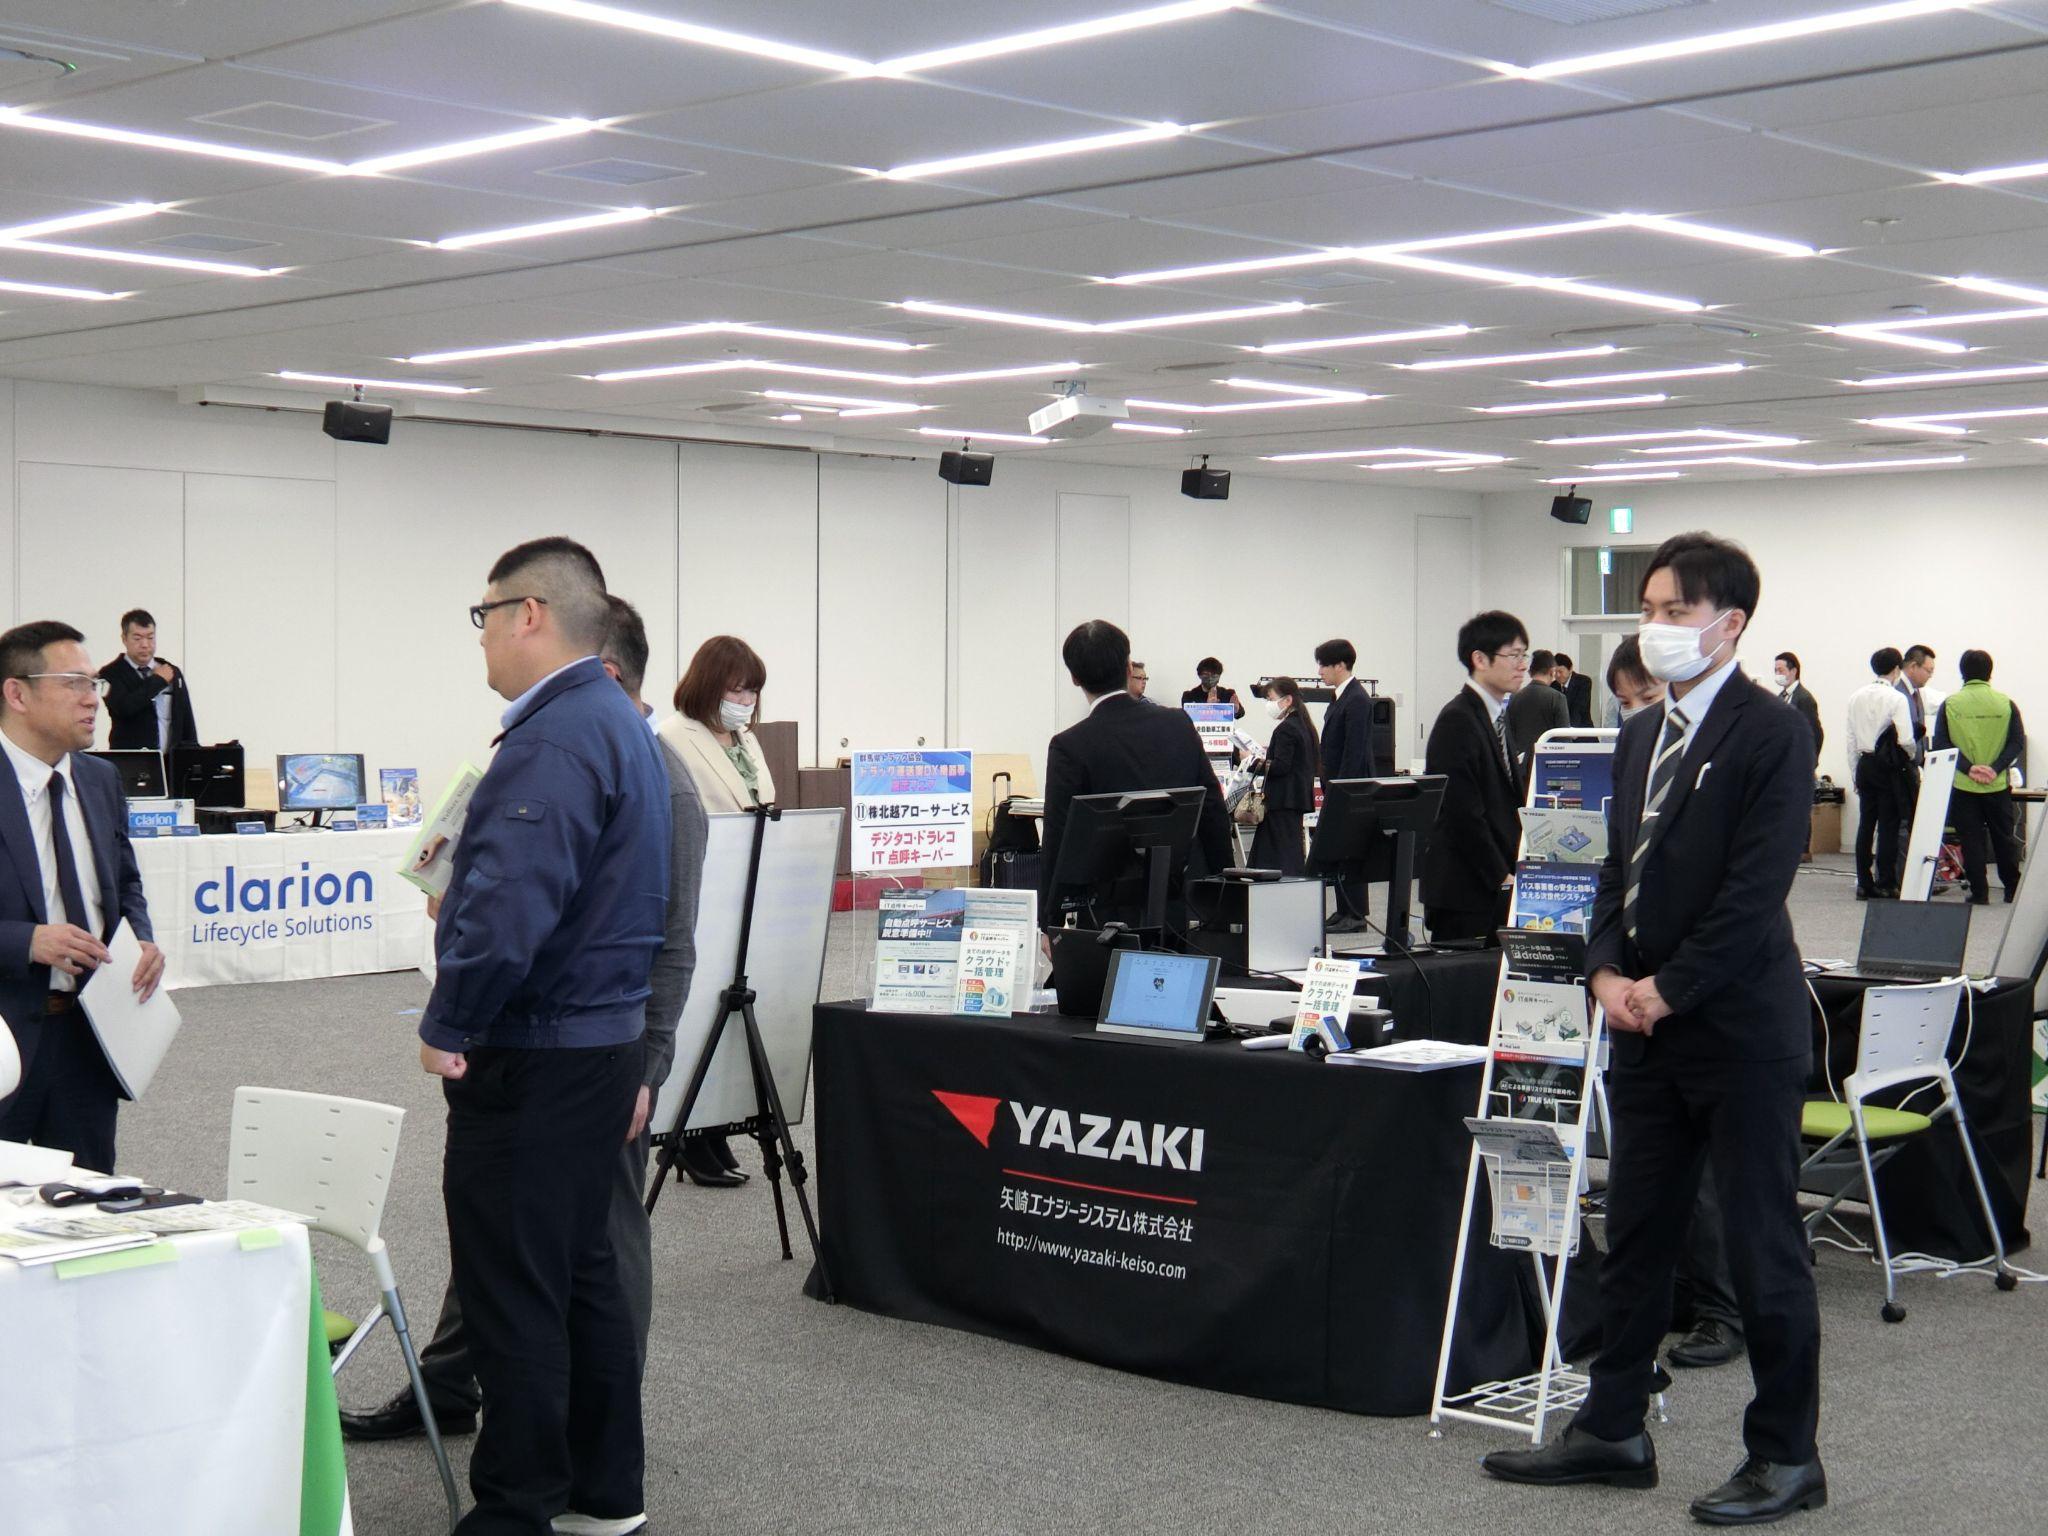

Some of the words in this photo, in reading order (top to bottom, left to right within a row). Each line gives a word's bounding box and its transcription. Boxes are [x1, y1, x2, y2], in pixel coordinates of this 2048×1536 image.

[135, 813, 173, 826] clarion
[872, 851, 885, 865] IT
[888, 848, 954, 865] 点呼キーパー
[194, 862, 373, 914] clarion
[192, 920, 278, 946] Lifecycle
[284, 912, 373, 937] Solutions
[884, 918, 953, 928] 自動点呼サービス
[964, 967, 1004, 977] 一括管理
[1305, 1000, 1340, 1012] 一括管理
[1009, 1101, 1205, 1172] YAZAKI
[1000, 1186, 1194, 1243] 矢崎エナジーシステム株式会社
[997, 1227, 1187, 1280] http://www.yazaki-keiso.com
